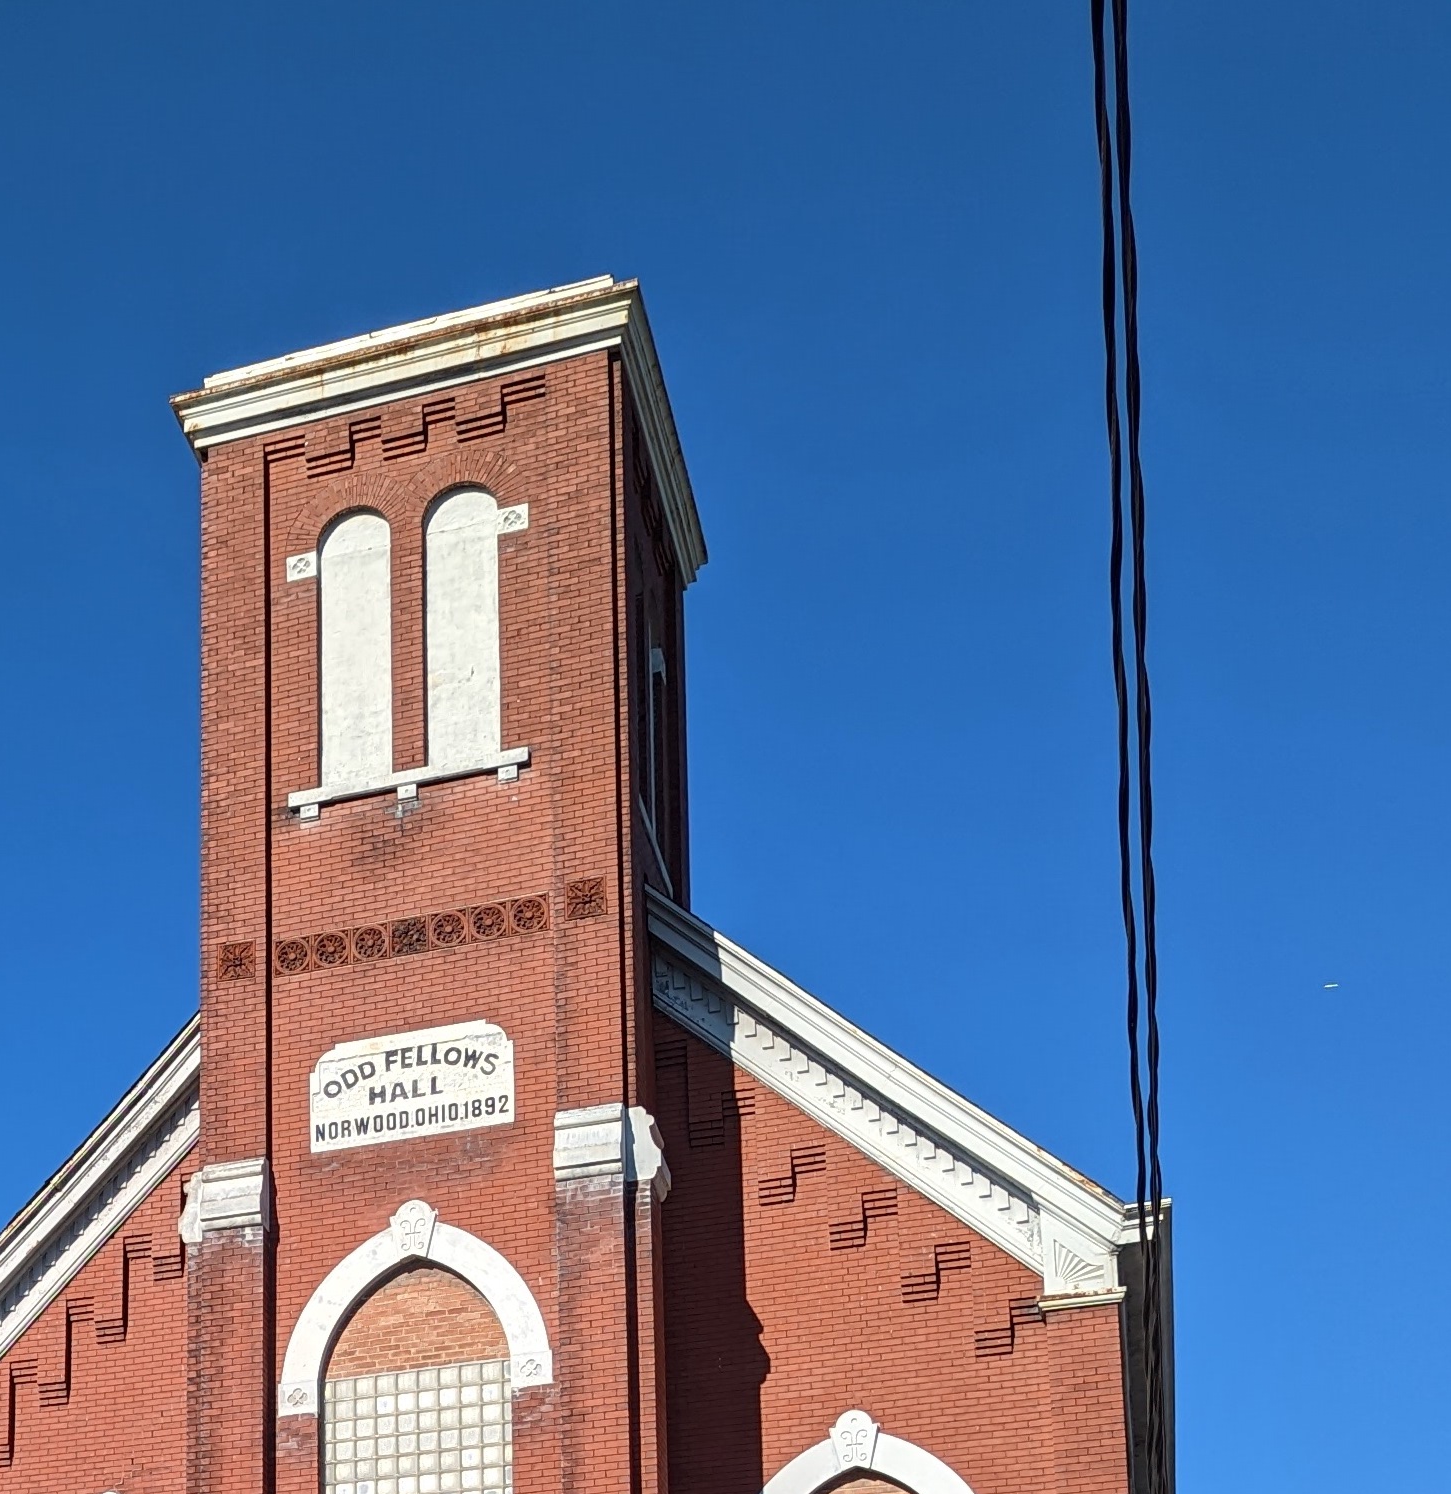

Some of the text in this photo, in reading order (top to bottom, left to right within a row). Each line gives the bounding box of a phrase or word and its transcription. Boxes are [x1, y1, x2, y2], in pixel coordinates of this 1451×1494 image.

[323, 1042, 500, 1098] ODD FELLOWS
[368, 1075, 444, 1106] HALL
